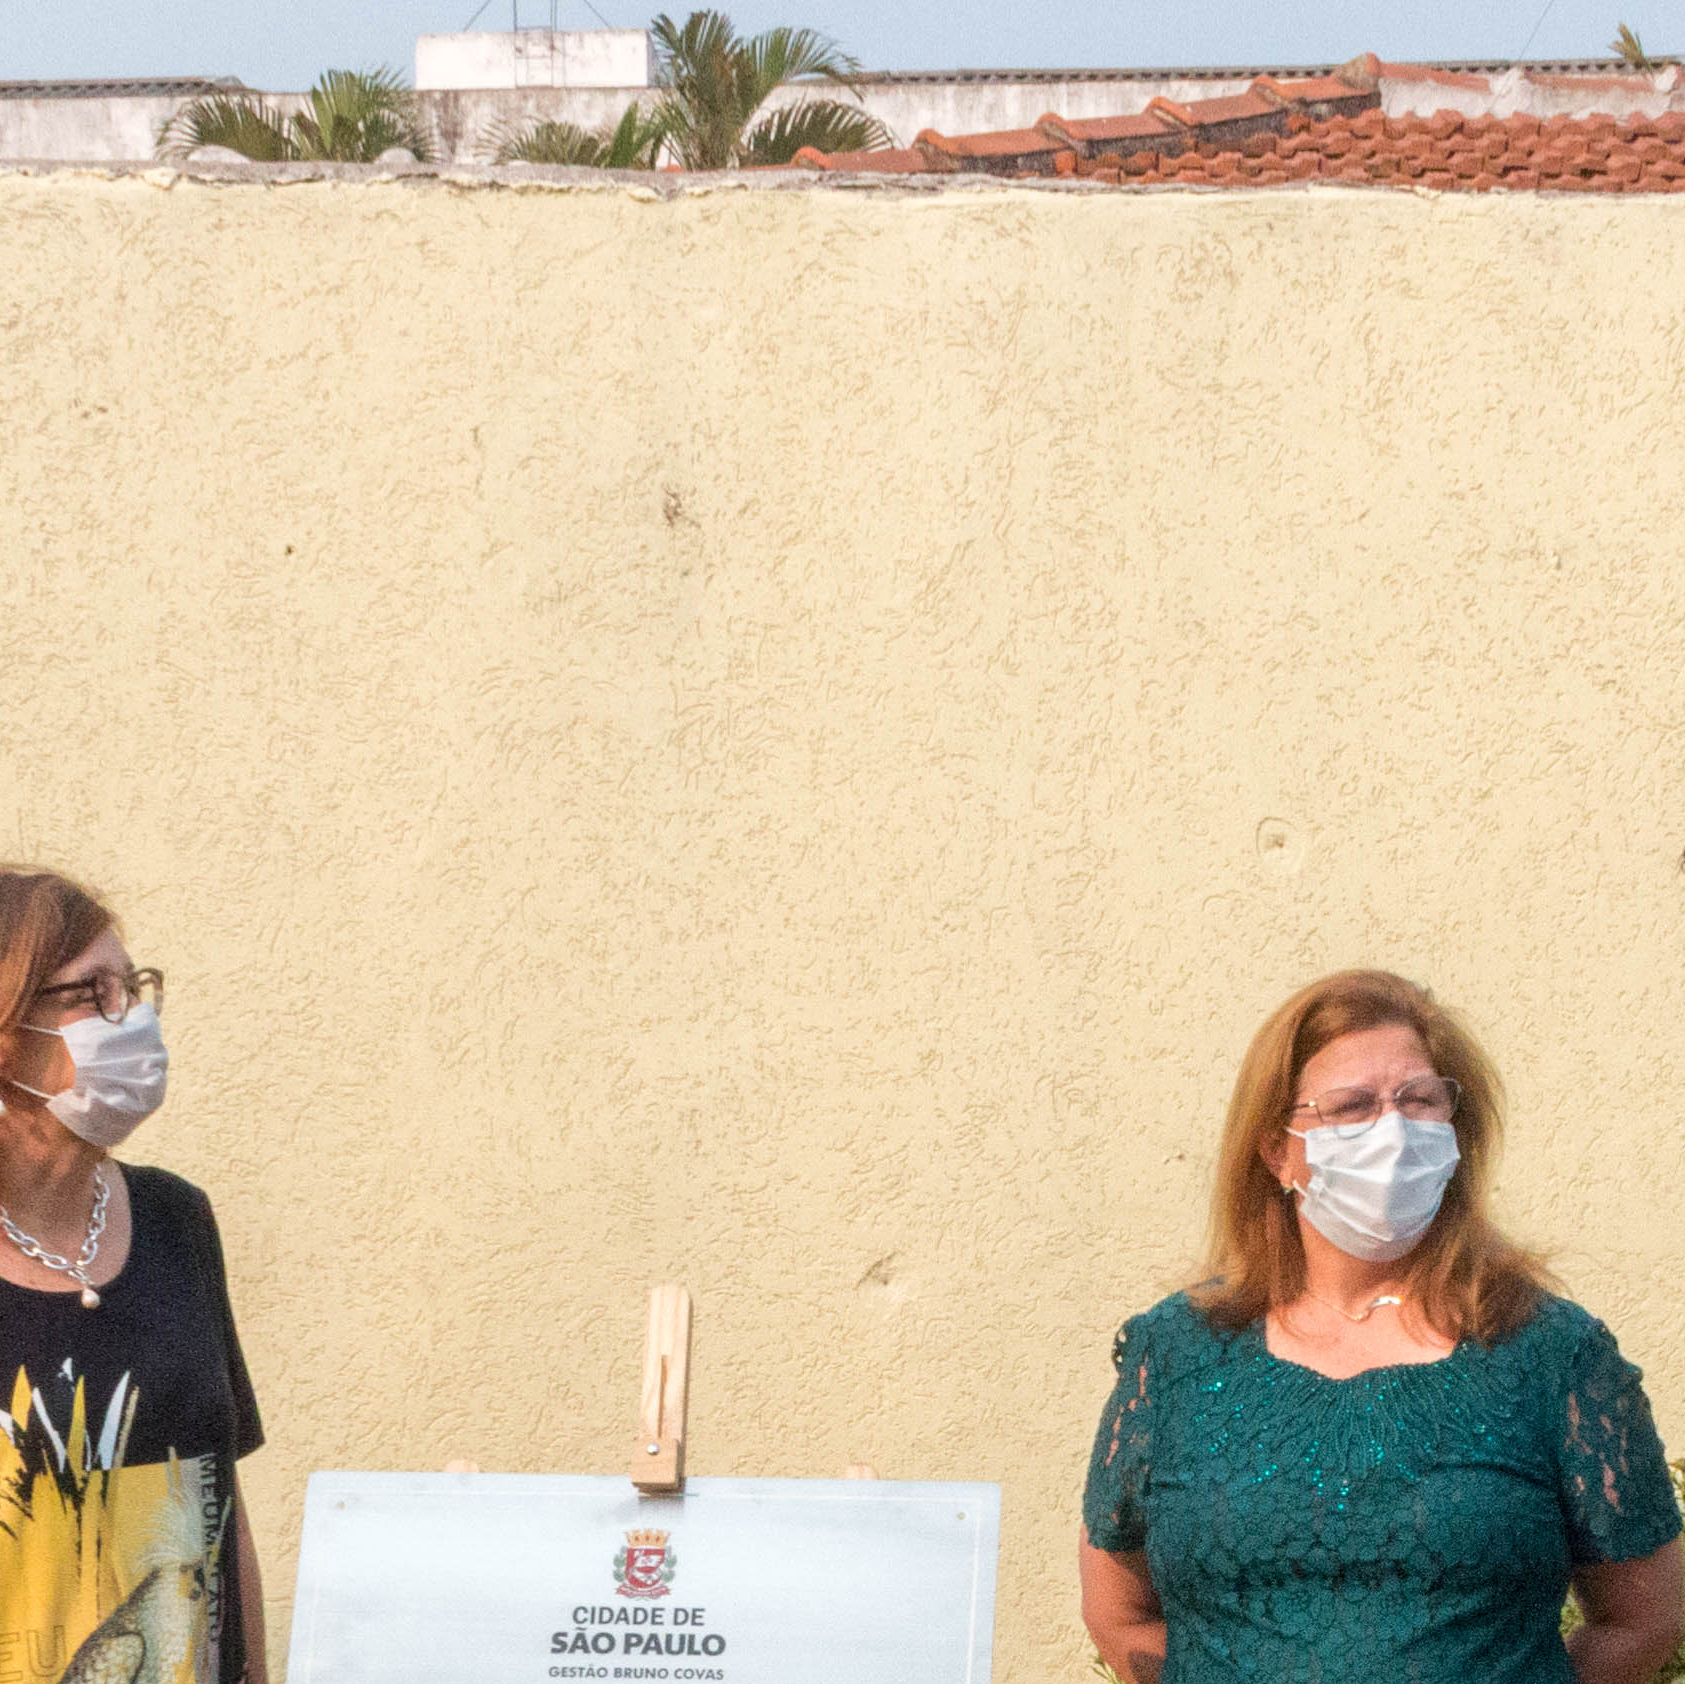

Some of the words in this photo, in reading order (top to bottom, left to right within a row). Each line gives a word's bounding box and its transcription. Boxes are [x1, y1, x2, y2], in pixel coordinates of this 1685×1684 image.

[572, 1606, 665, 1626] CIDADE
[673, 1608, 706, 1626] DE
[550, 1622, 616, 1655] SÃO
[622, 1632, 727, 1657] PAULO
[548, 1663, 609, 1679] GESTÃO
[613, 1667, 669, 1680] BRUNO
[673, 1668, 725, 1681] COVAS
